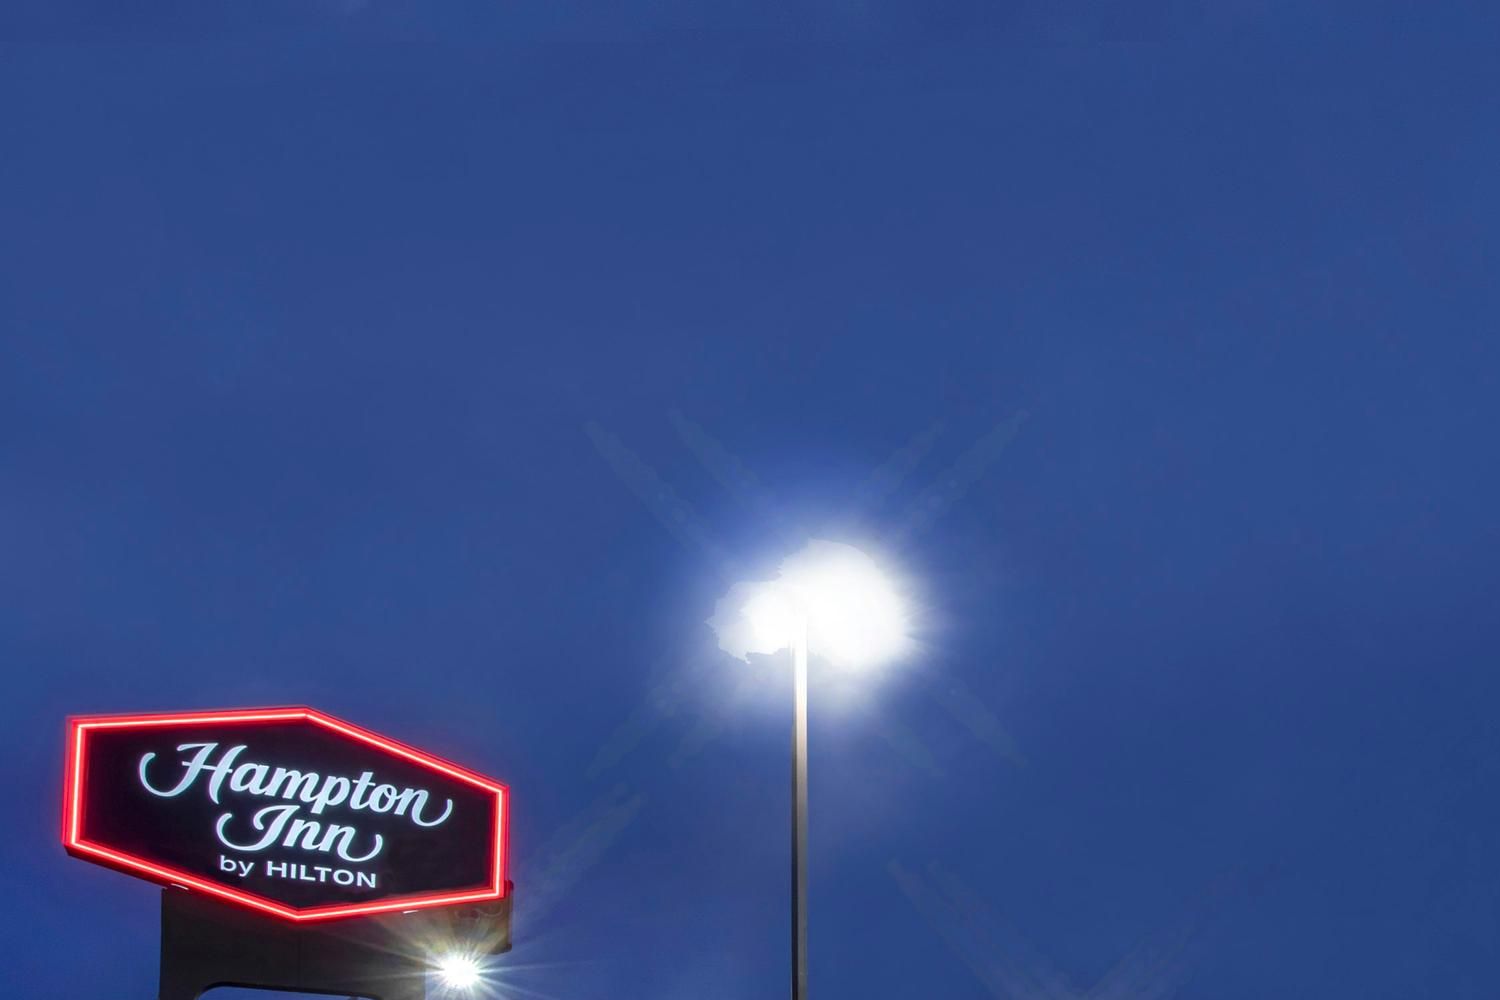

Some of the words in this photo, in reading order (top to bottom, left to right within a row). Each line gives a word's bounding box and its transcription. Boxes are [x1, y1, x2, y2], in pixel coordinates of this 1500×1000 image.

[139, 742, 453, 826] Hampton
[216, 805, 383, 862] Inn
[220, 855, 254, 877] by
[266, 861, 377, 888] HILTON
